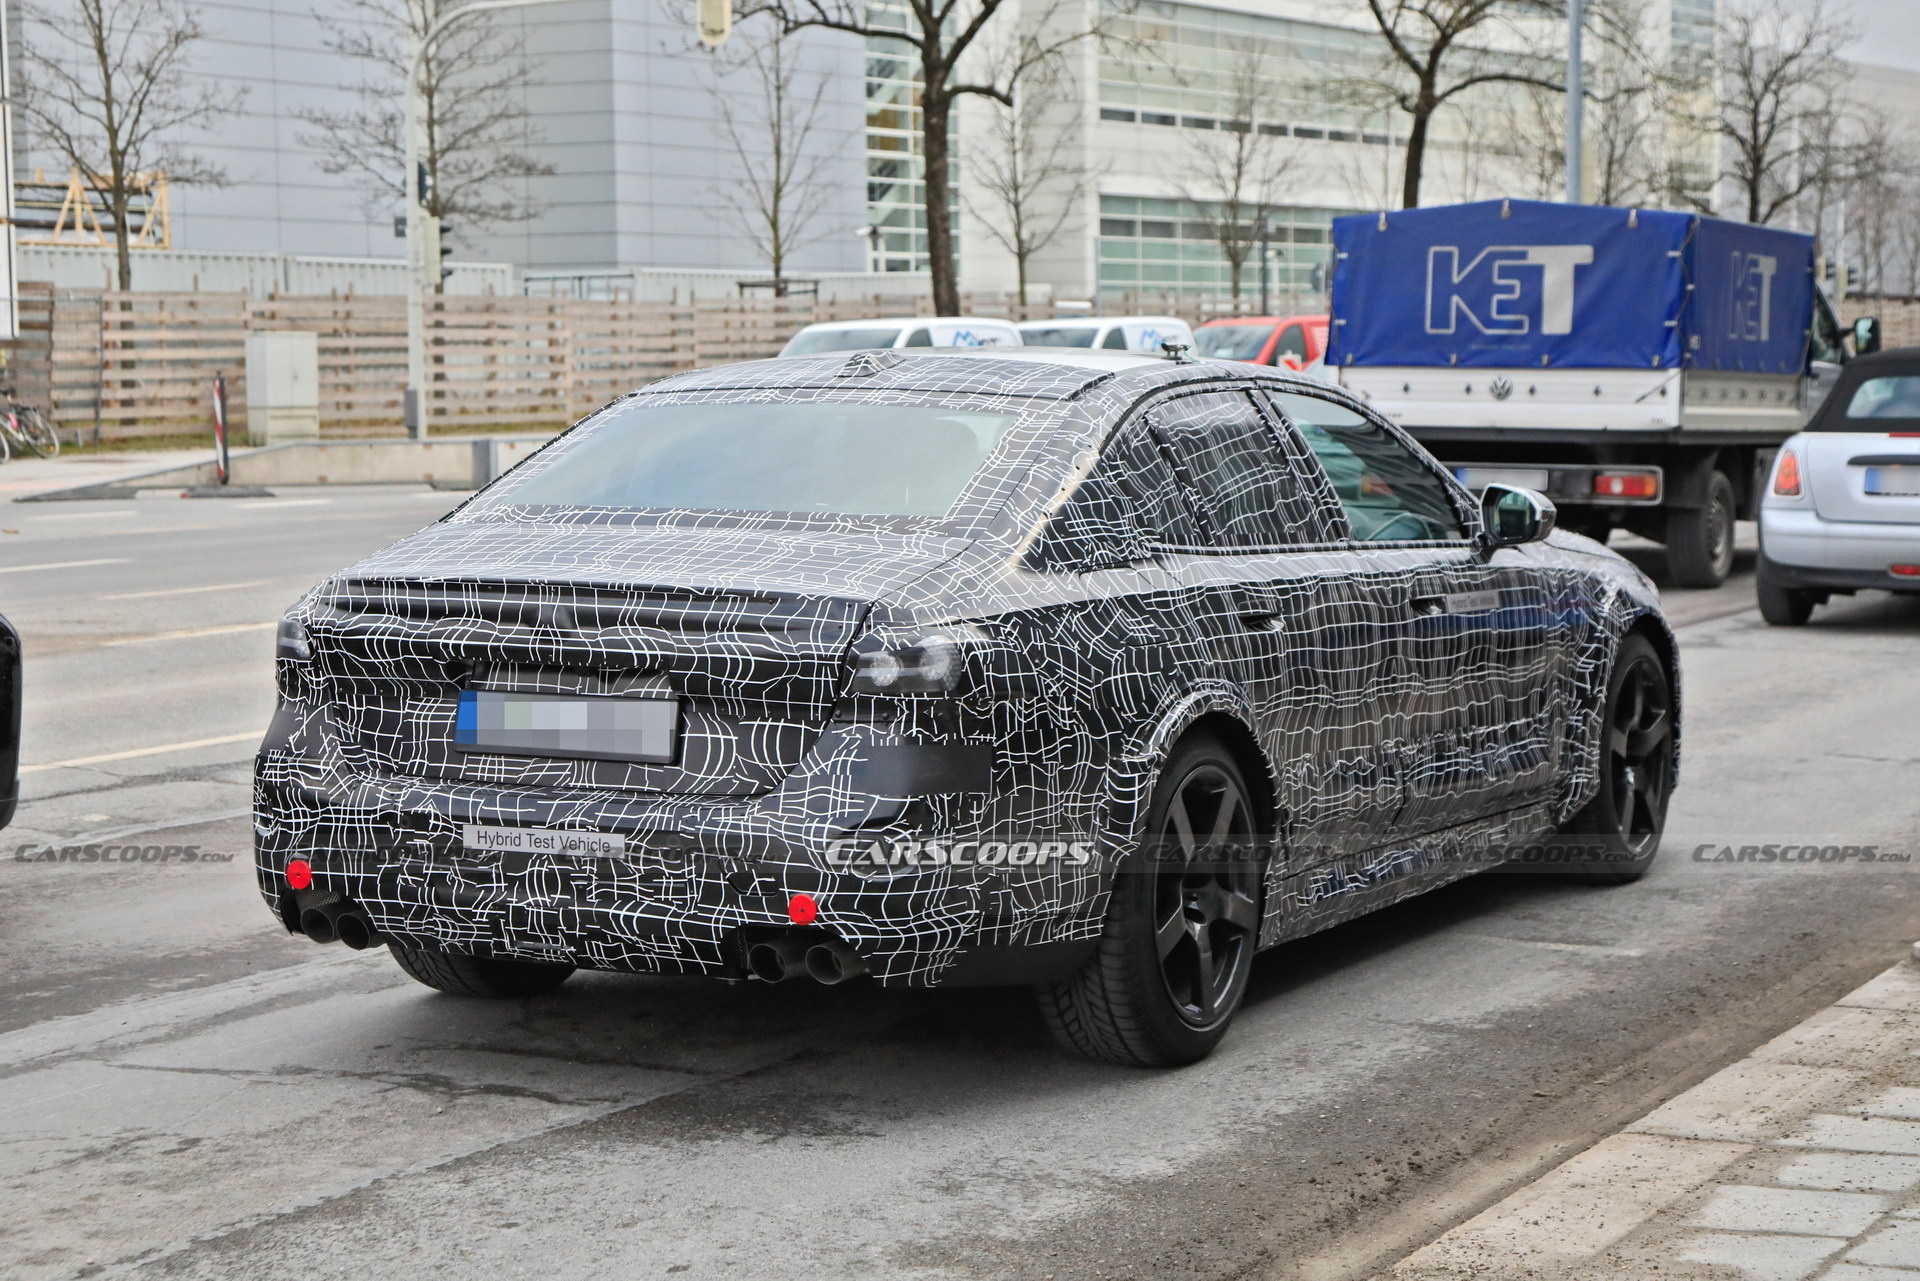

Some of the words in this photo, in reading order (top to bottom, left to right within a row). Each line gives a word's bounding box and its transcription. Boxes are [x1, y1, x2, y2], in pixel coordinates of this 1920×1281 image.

[1425, 245, 1594, 335] KET
[1727, 250, 1777, 342] KET
[477, 830, 521, 849] Hybrid
[526, 833, 555, 849] Test
[560, 835, 611, 853] Vehicle
